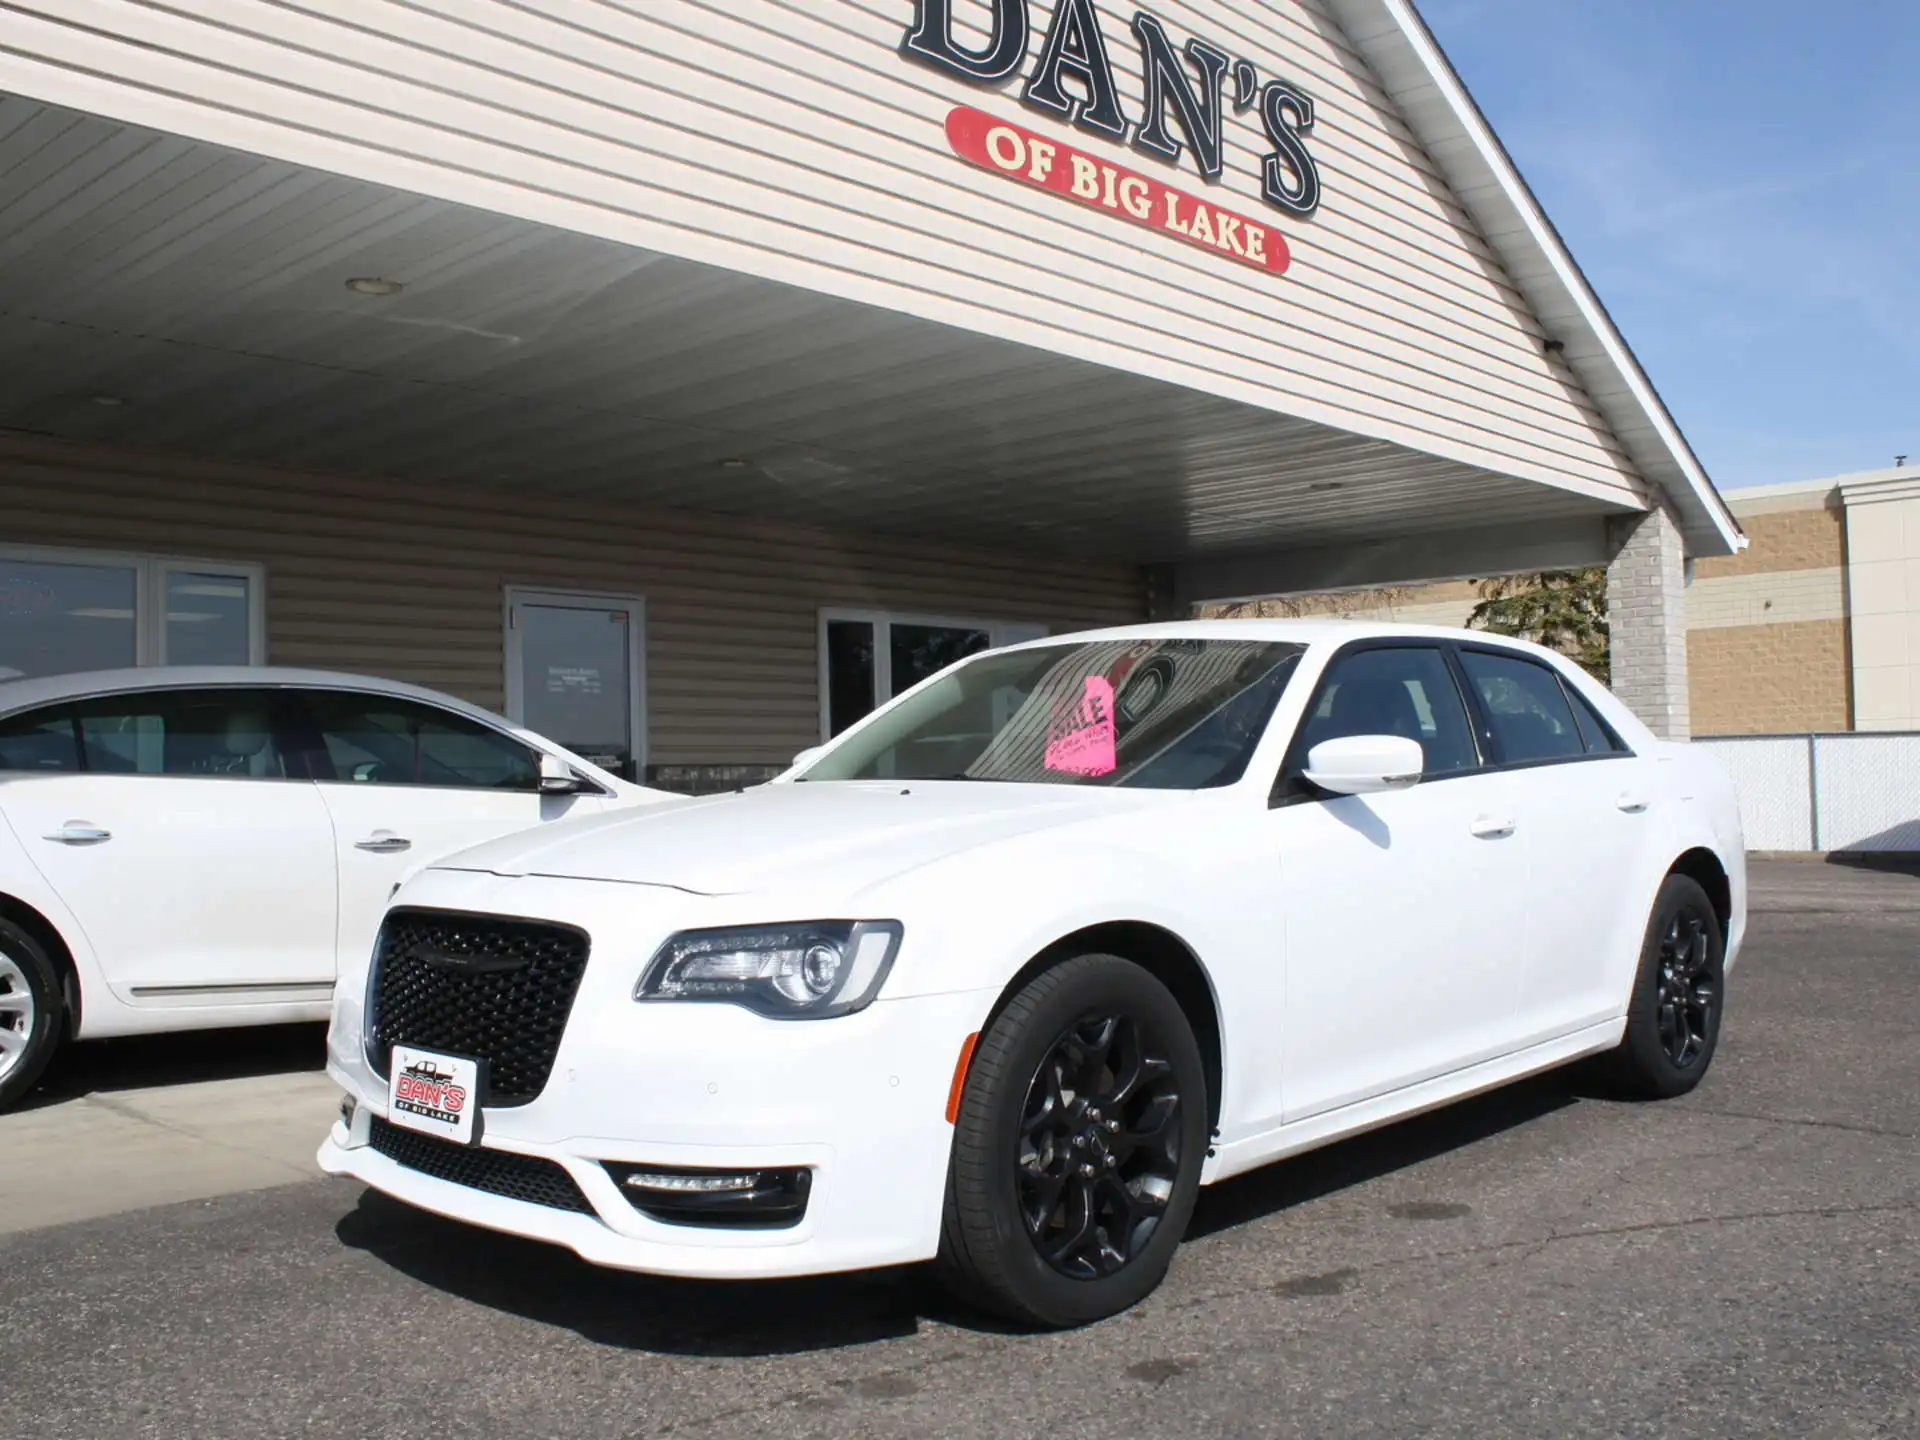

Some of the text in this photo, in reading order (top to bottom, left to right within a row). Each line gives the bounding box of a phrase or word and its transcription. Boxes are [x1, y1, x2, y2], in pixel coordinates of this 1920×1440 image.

[901, 0, 1320, 214] DAN'S
[986, 127, 1267, 264] OF BIG LAKE
[396, 1074, 466, 1112] DAN'S
[398, 1101, 456, 1122] OF BIG LAKE
